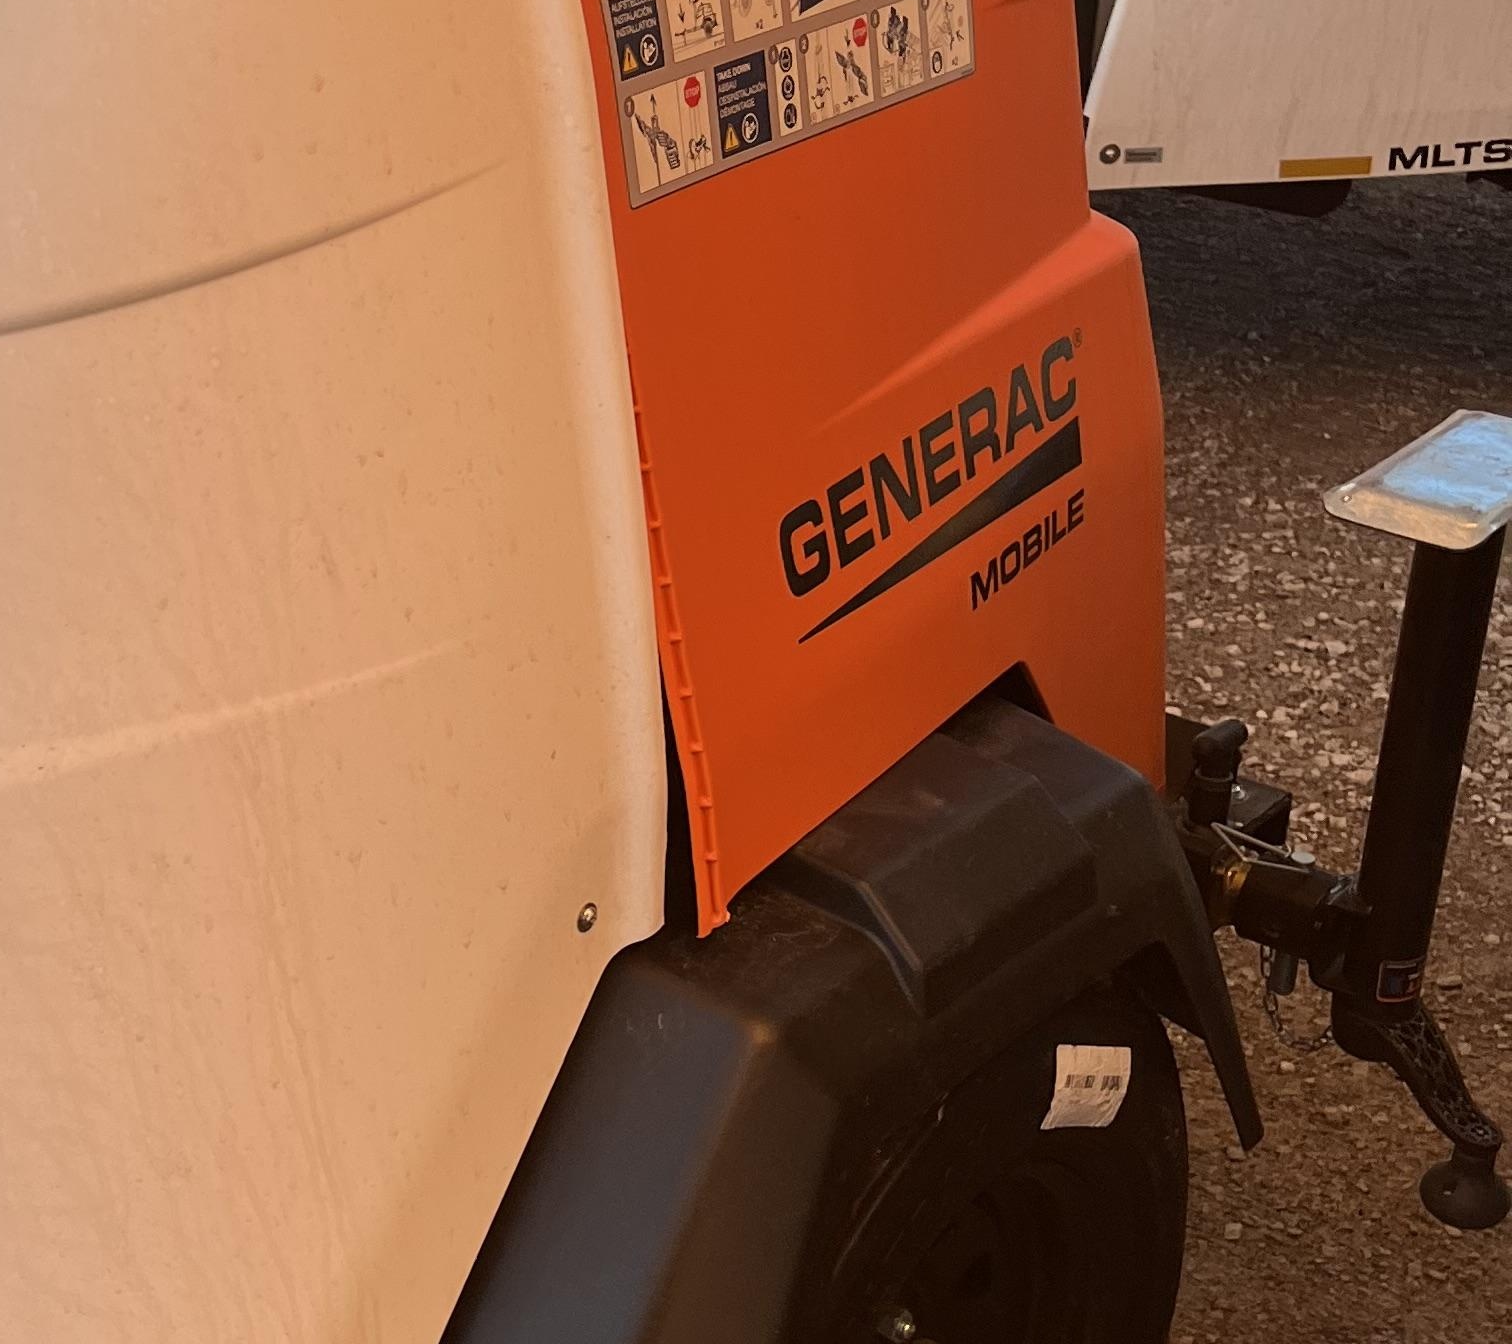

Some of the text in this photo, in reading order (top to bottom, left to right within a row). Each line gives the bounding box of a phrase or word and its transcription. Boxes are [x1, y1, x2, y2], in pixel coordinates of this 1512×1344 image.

[1388, 138, 1512, 171] MLTS
[779, 336, 1077, 598] GENERAC
[969, 488, 1085, 611] MOBILE
